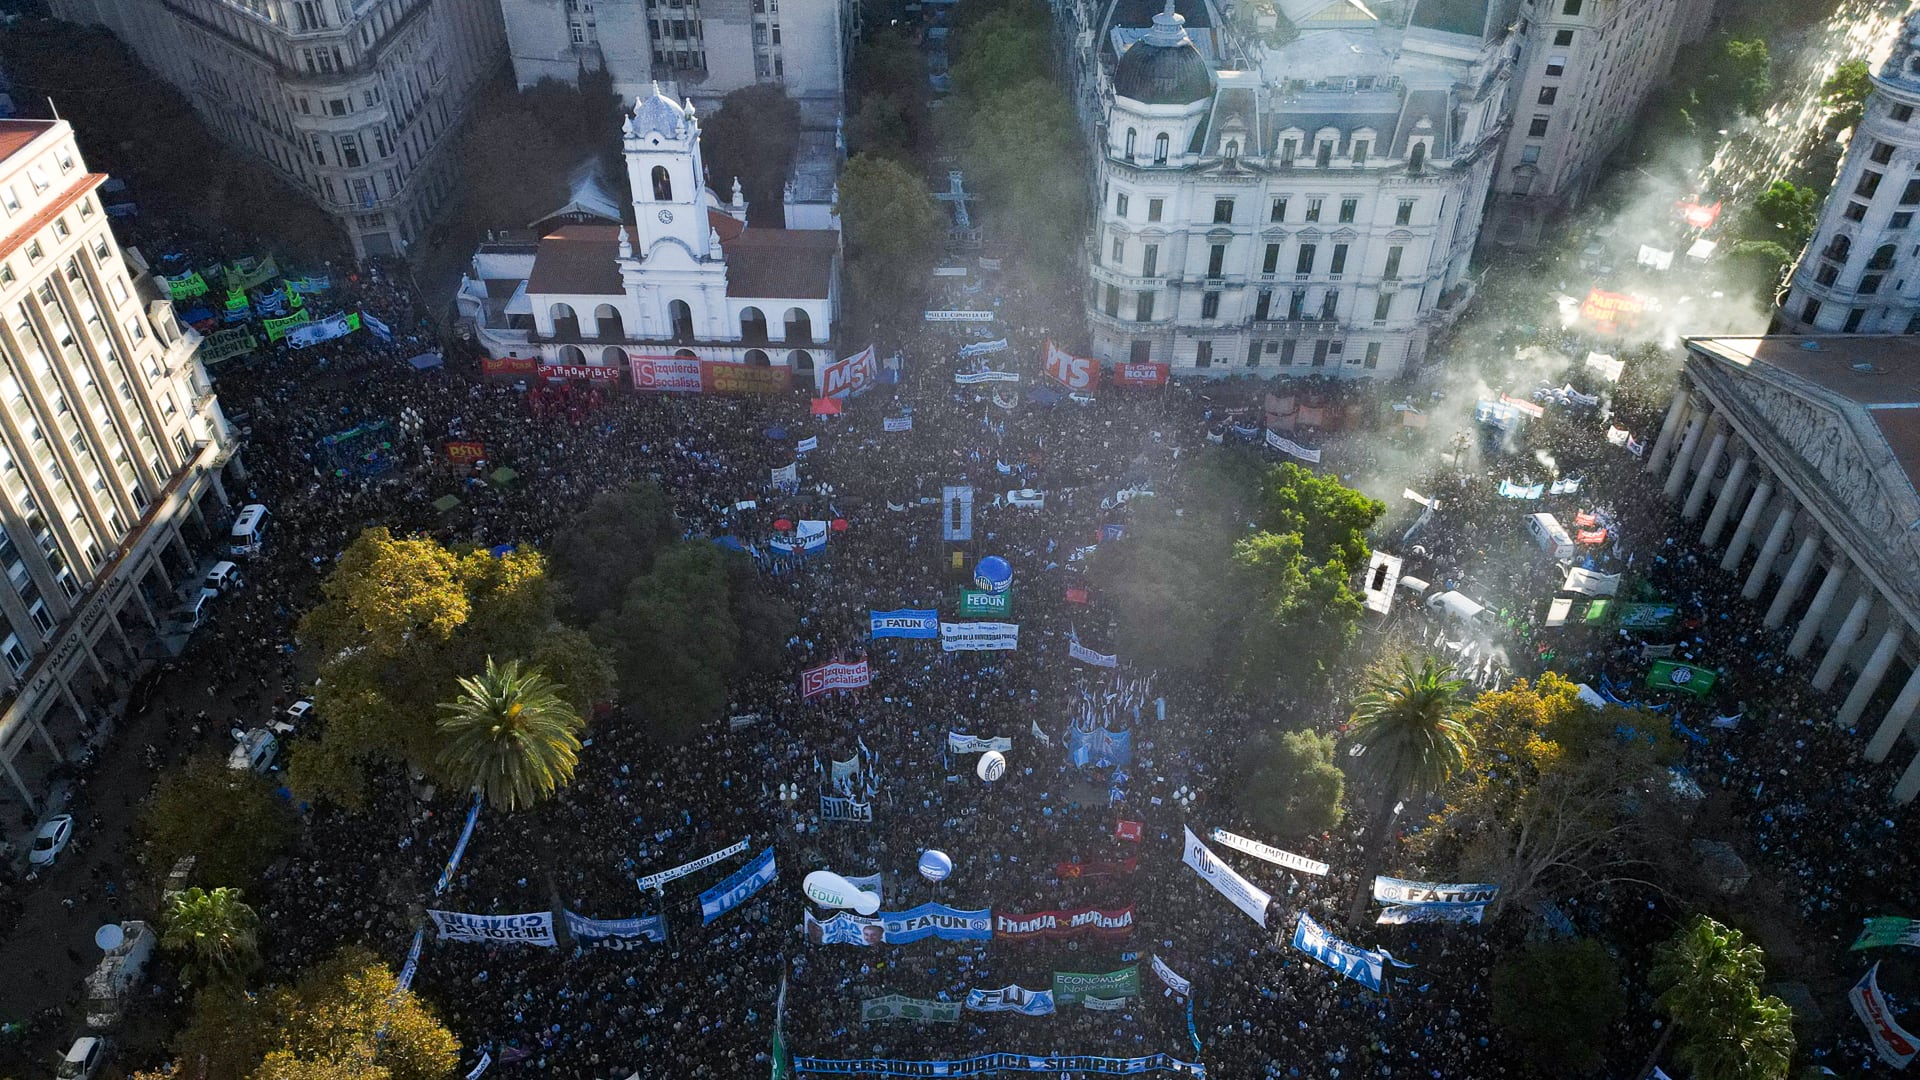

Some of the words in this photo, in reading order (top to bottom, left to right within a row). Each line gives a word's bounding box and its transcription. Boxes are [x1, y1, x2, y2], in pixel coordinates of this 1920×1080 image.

[268, 314, 305, 330] UOCRA
[209, 328, 247, 346] UOCRA
[201, 338, 250, 361] PRESENTE
[553, 366, 619, 378] IRROMPIBLES
[655, 362, 699, 375] izquierda
[1047, 342, 1090, 387] PTS
[713, 365, 785, 380] PARTIDO
[829, 354, 876, 392] MST
[1125, 370, 1157, 378] ROJA
[655, 377, 700, 389] socialista
[968, 594, 1005, 606] FEDUN
[886, 619, 922, 628] FATUN
[33, 679, 46, 693] LA
[47, 632, 78, 674] FRANCO
[80, 575, 121, 630] ARGENTINA
[824, 665, 867, 676] izquierda
[824, 675, 868, 685] socialista
[719, 874, 768, 911] UDA
[1408, 888, 1495, 902] FATUN
[906, 915, 967, 930] FATUN
[998, 915, 1056, 933] FRANJA
[1070, 910, 1133, 928] MORADA
[1295, 922, 1381, 993] UDA
[801, 1058, 934, 1075] UNIVERSIDAD
[1044, 1056, 1129, 1073] SIEMPRE
